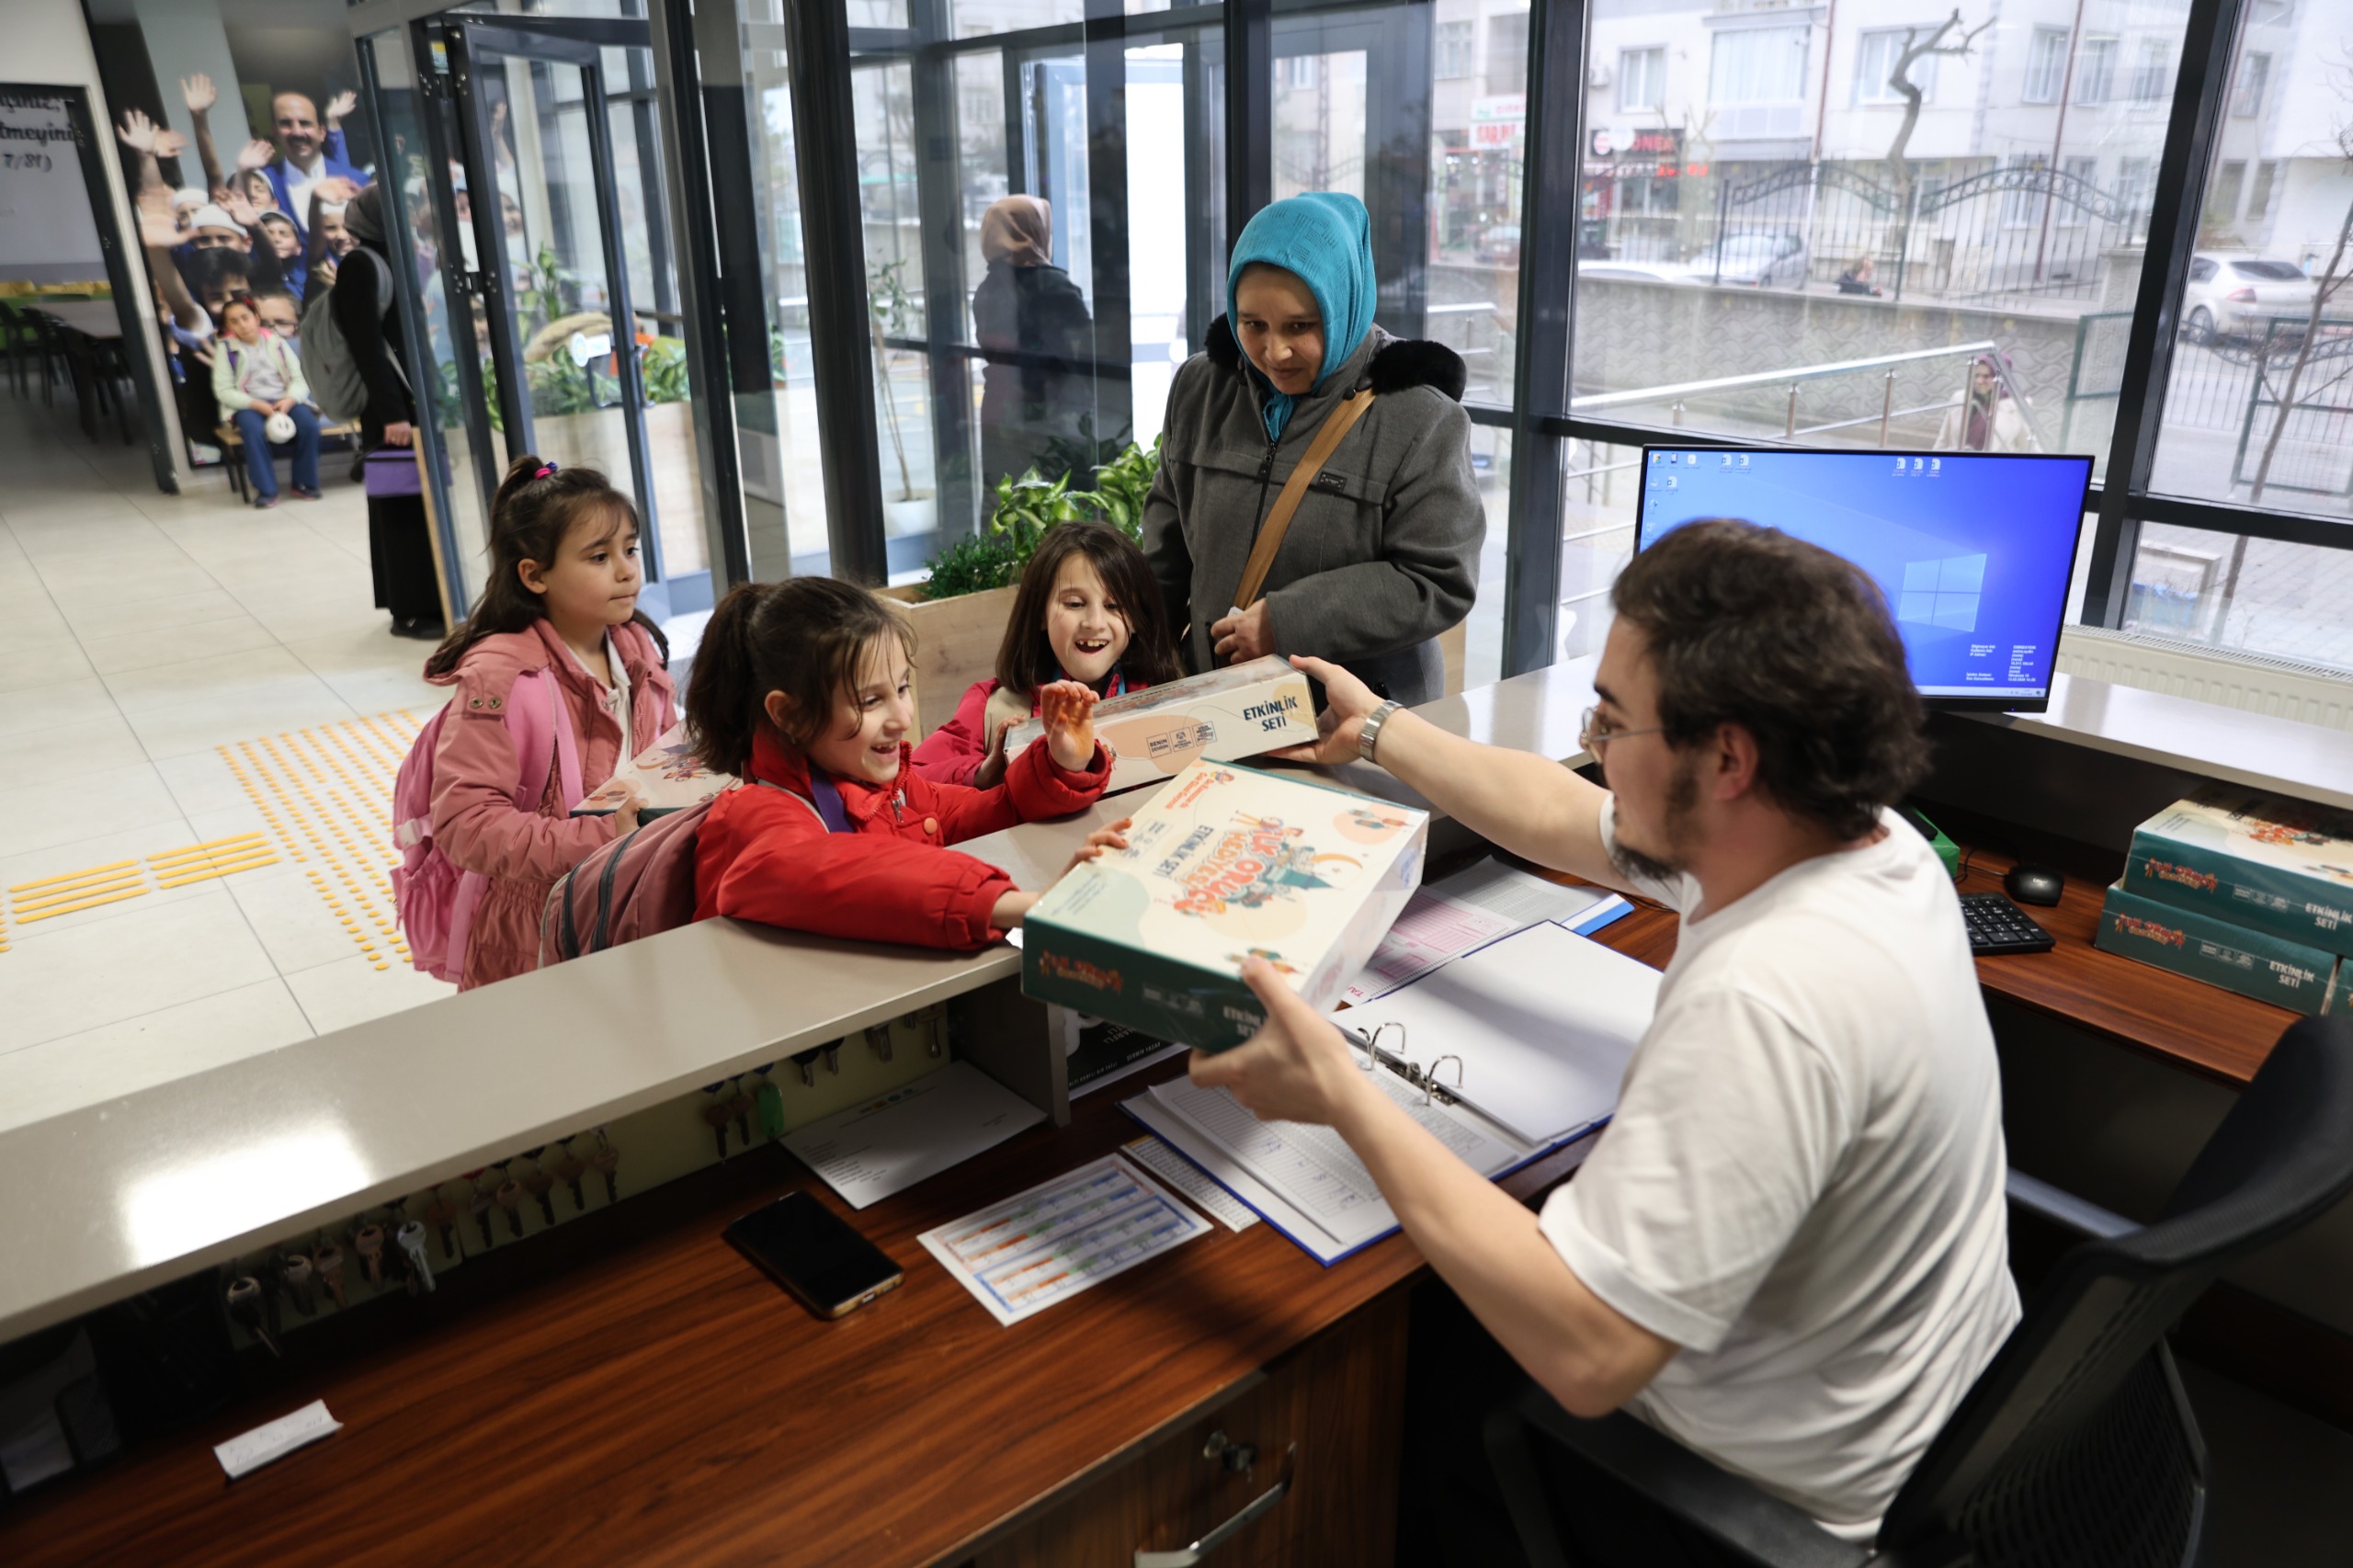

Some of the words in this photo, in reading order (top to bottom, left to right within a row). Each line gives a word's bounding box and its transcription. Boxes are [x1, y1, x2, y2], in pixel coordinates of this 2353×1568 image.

[1243, 695, 1298, 722] ETKİNLİK
[1261, 714, 1287, 733] SETİ
[1250, 829, 1283, 856] İLK
[1179, 831, 1249, 892] HEDİYESİ
[1188, 858, 1263, 902] ORUÇ
[2305, 902, 2353, 925] ETKİNLİK
[2314, 916, 2338, 931] SETİ
[2268, 960, 2314, 983] ETKİNLİK
[2278, 974, 2301, 989] SETİ
